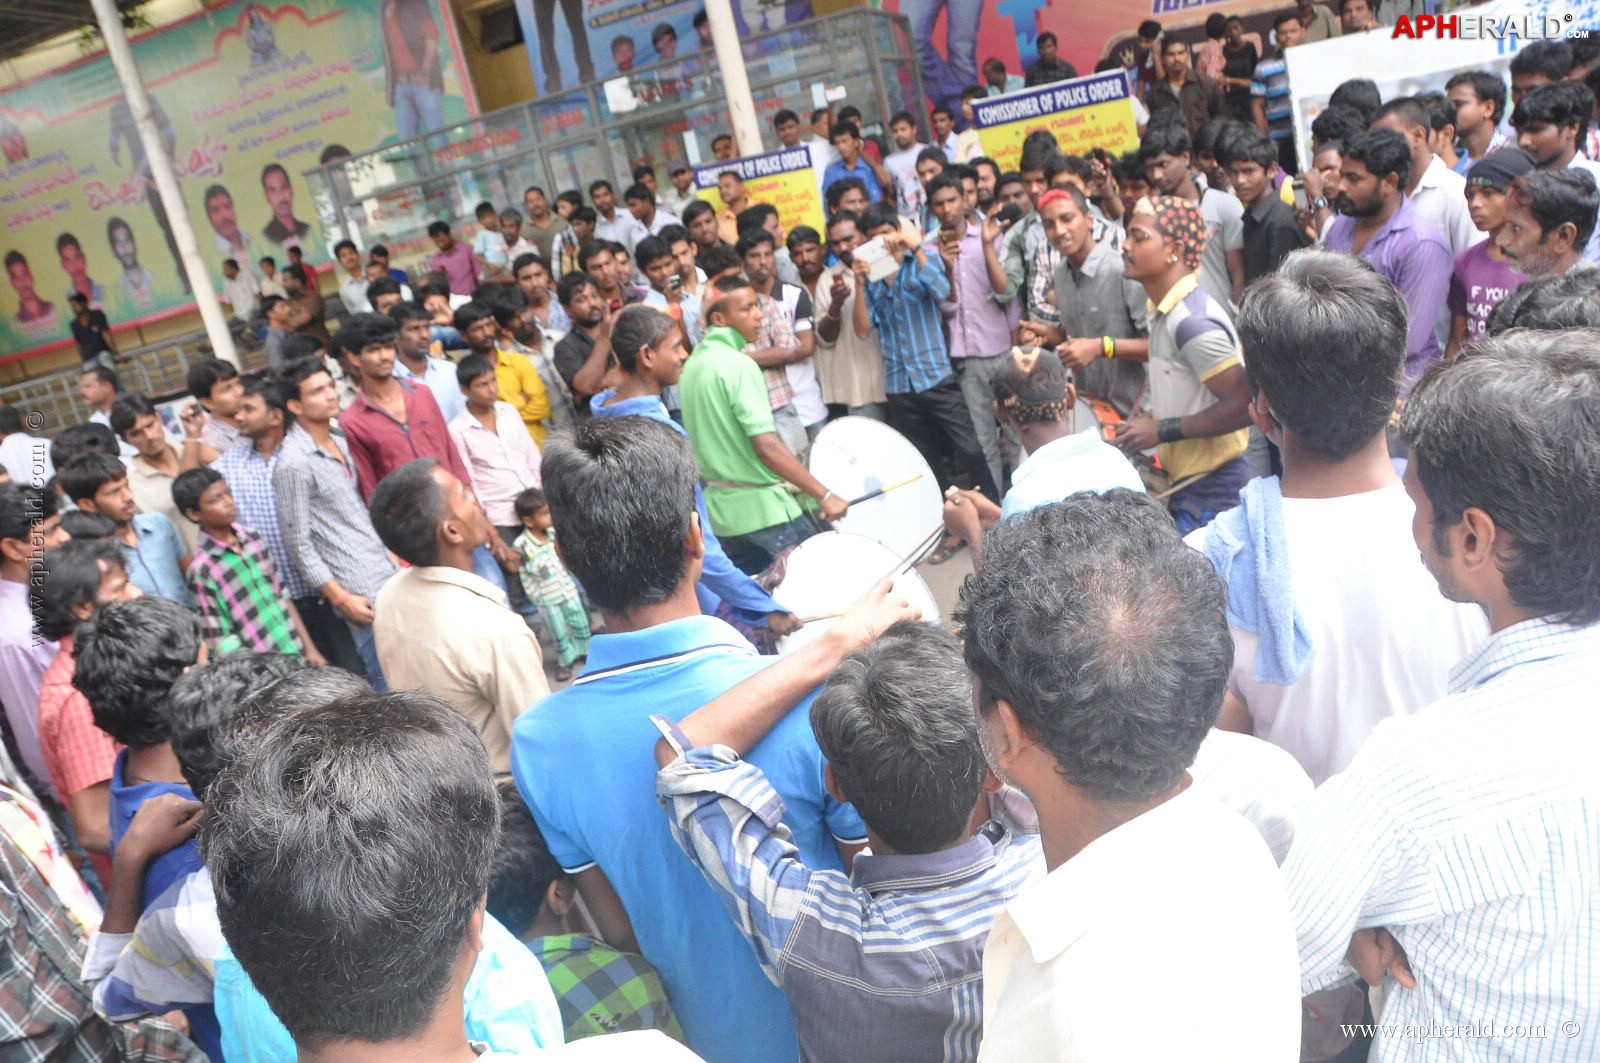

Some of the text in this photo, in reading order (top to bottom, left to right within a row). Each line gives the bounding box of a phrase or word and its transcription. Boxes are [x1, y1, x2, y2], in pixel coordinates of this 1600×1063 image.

[978, 97, 1041, 126] COMISSIONER
[1042, 95, 1054, 113] OF
[1054, 86, 1089, 110] POLICE
[1088, 78, 1124, 102] ORDER
[744, 160, 755, 178] OF
[755, 156, 781, 175] POLICE
[780, 150, 809, 171] ORDER
